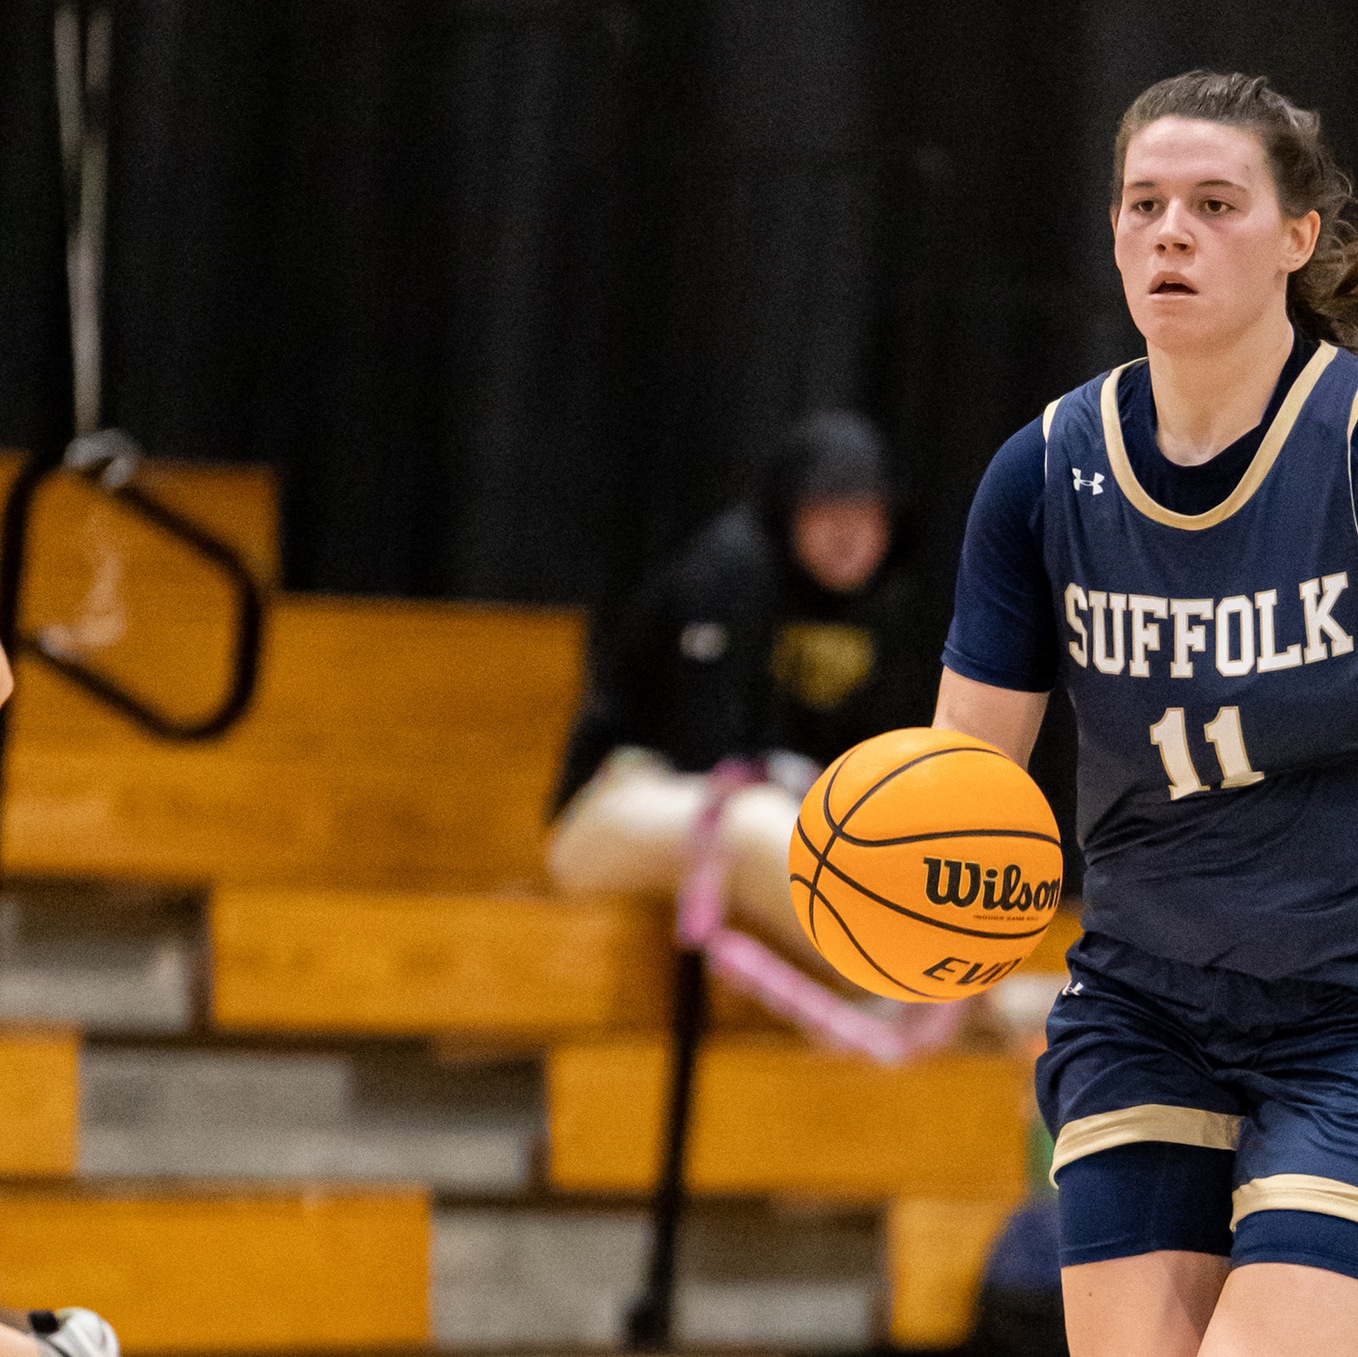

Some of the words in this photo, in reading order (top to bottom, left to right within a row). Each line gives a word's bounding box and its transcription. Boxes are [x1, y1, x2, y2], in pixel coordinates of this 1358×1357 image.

[1064, 571, 1354, 678] SUFFOLK
[1150, 706, 1265, 800] 11
[923, 857, 1061, 912] Wilson
